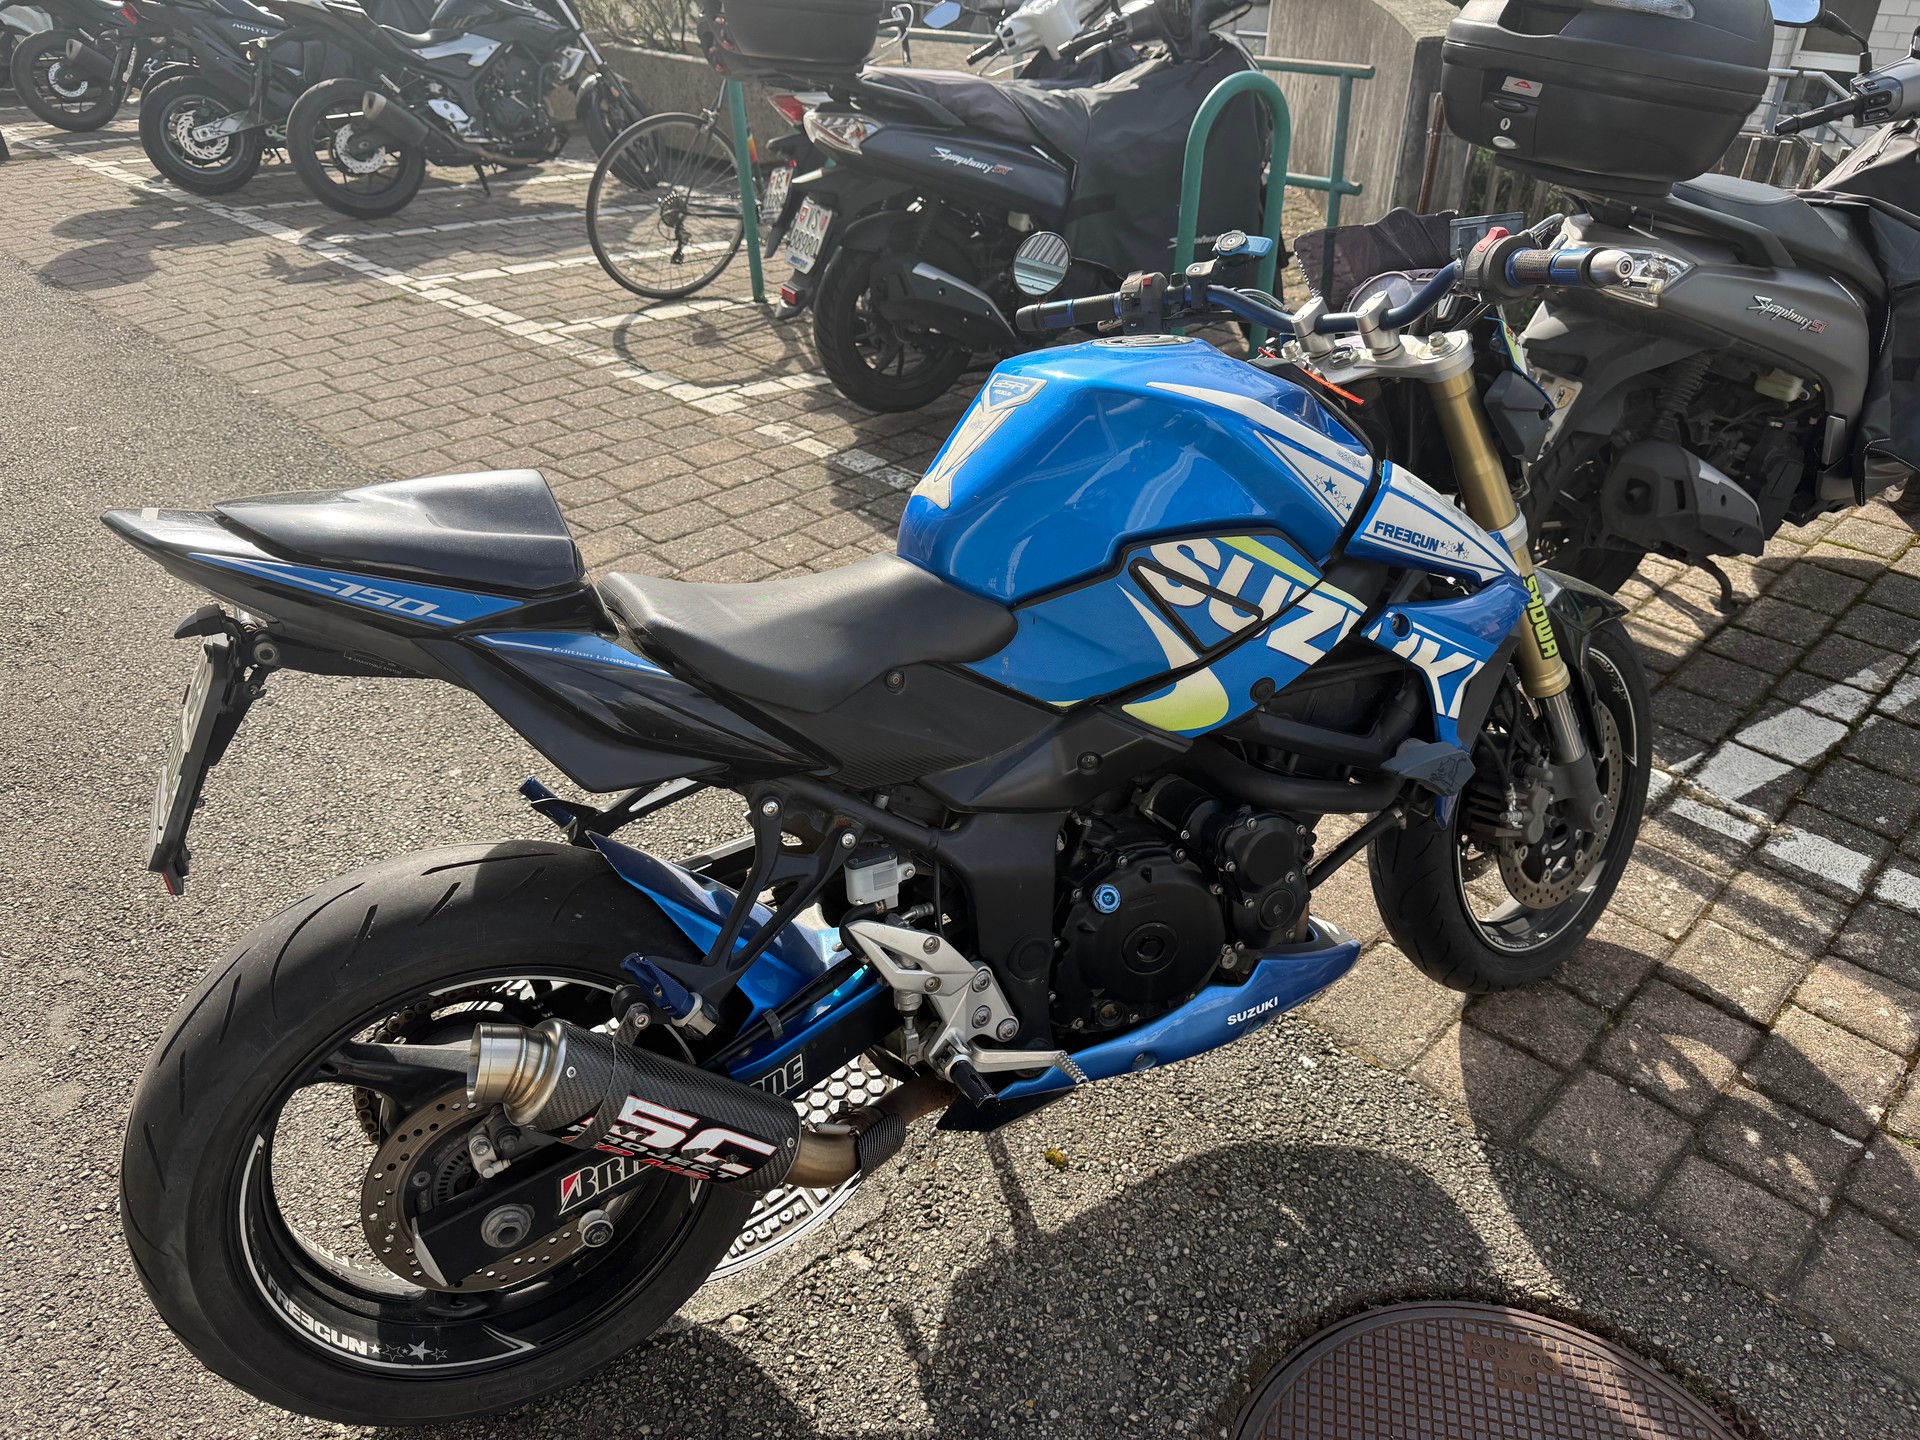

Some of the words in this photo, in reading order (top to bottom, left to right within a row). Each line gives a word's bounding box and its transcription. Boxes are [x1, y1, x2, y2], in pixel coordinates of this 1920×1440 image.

[930, 146, 994, 174] Symphony
[1746, 295, 1812, 331] Symphony
[329, 577, 440, 616] 750
[1522, 572, 1560, 660] SHOWA
[1227, 996, 1278, 1025] SUZUKI
[267, 1272, 367, 1356] FREEGUN
